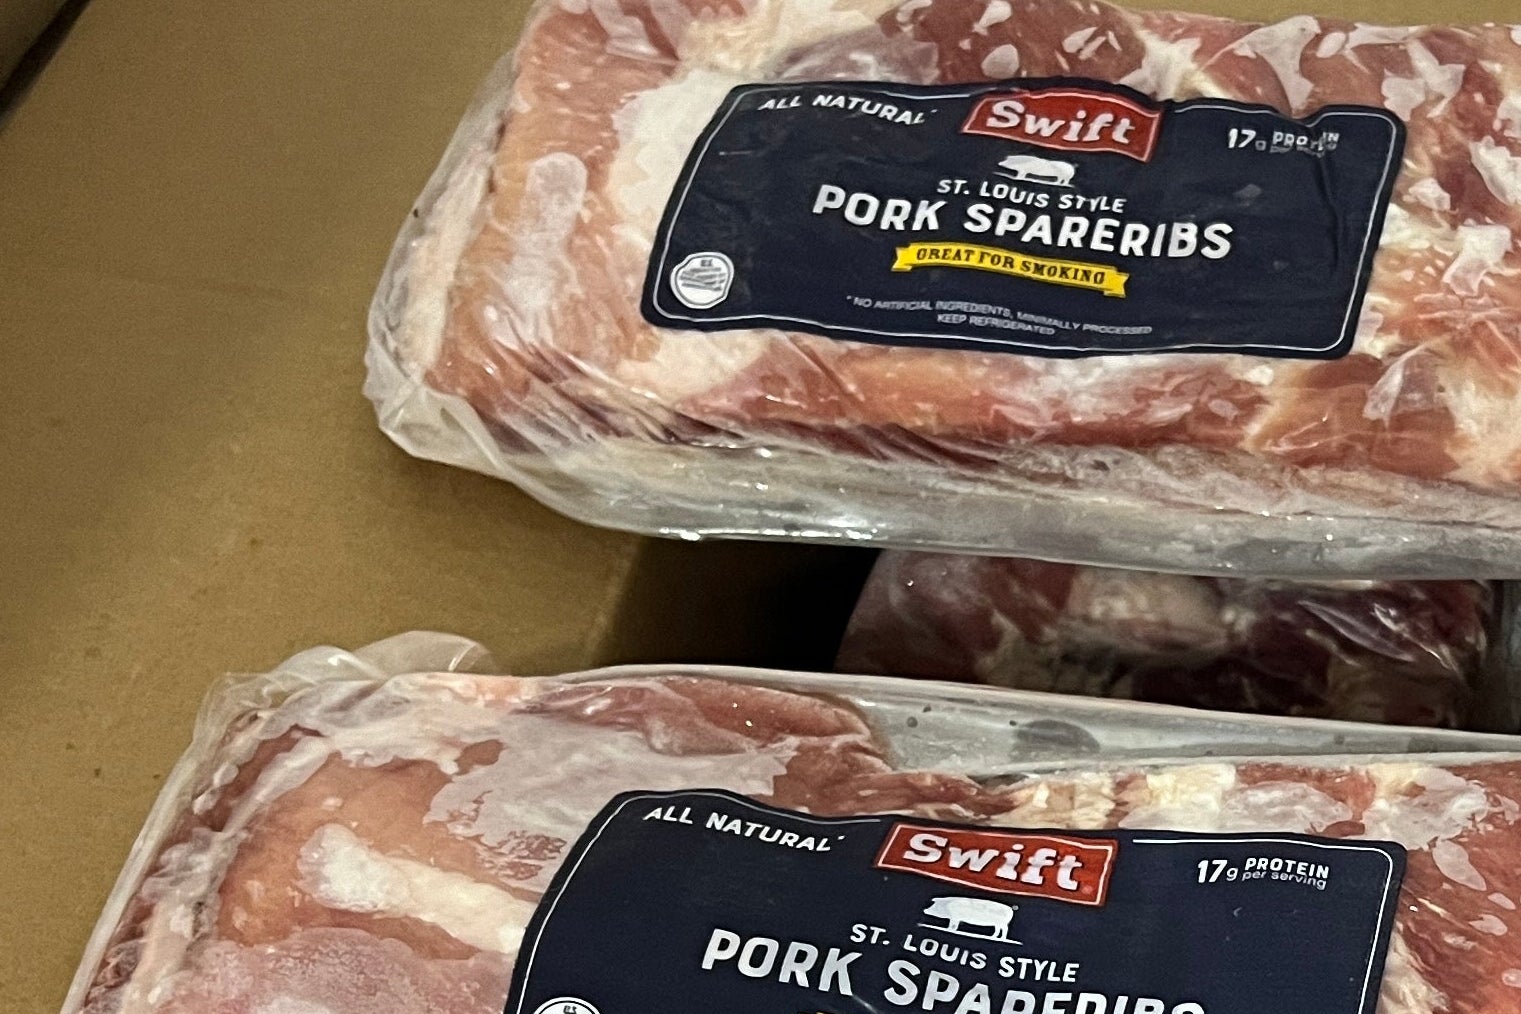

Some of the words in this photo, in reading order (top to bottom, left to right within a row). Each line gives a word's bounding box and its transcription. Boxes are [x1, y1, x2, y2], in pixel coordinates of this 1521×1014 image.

[758, 95, 802, 111] ALL
[986, 100, 1136, 144] Swift
[936, 179, 970, 194] ST.
[980, 181, 1049, 209] LOUIS
[1058, 194, 1128, 214] STYLE
[812, 184, 947, 231] PORK
[963, 203, 1234, 259] SPARERIBS
[916, 248, 976, 263] GREAT
[978, 249, 1016, 269] FOR
[1020, 260, 1106, 285] SMOKING
[873, 300, 934, 311] ARTIFICIAL
[1082, 323, 1152, 335] PROCESSED
[937, 313, 967, 324] KEEP
[969, 315, 1055, 336] REFRIGERATED
[642, 806, 693, 825] ALL
[902, 832, 1082, 891] Swift
[1198, 859, 1239, 883] 17g
[1245, 857, 1329, 879] PROTEIN
[1241, 870, 1267, 882] per
[1271, 871, 1327, 891] serving
[701, 928, 863, 997] PORK
[849, 923, 890, 946] ST.
[903, 933, 988, 970] LOUIS
[998, 955, 1081, 984] STYLE
